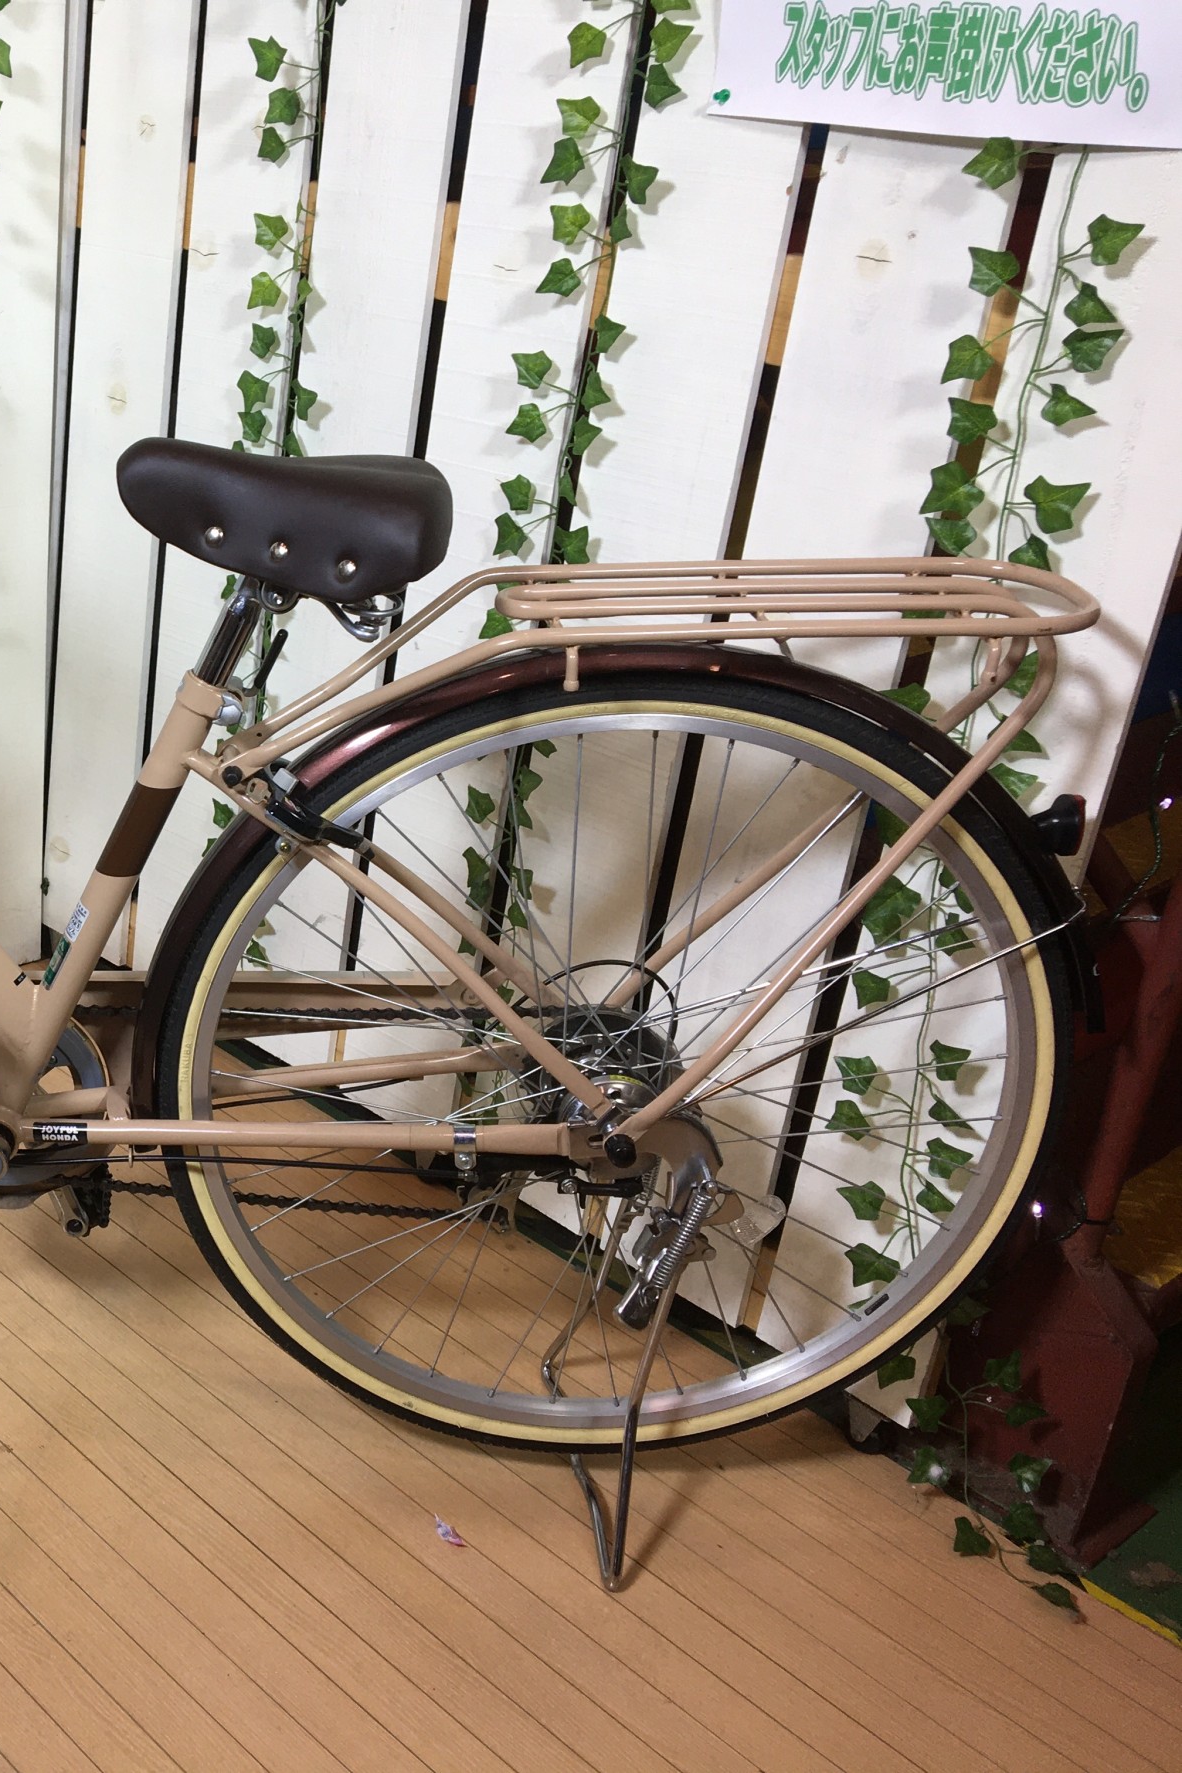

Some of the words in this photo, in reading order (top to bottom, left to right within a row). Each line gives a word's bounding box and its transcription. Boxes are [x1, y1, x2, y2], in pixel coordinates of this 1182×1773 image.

[775, 1, 1149, 112] スタッフにお声掛けください。
[41, 1125, 78, 1134] JOYFUL
